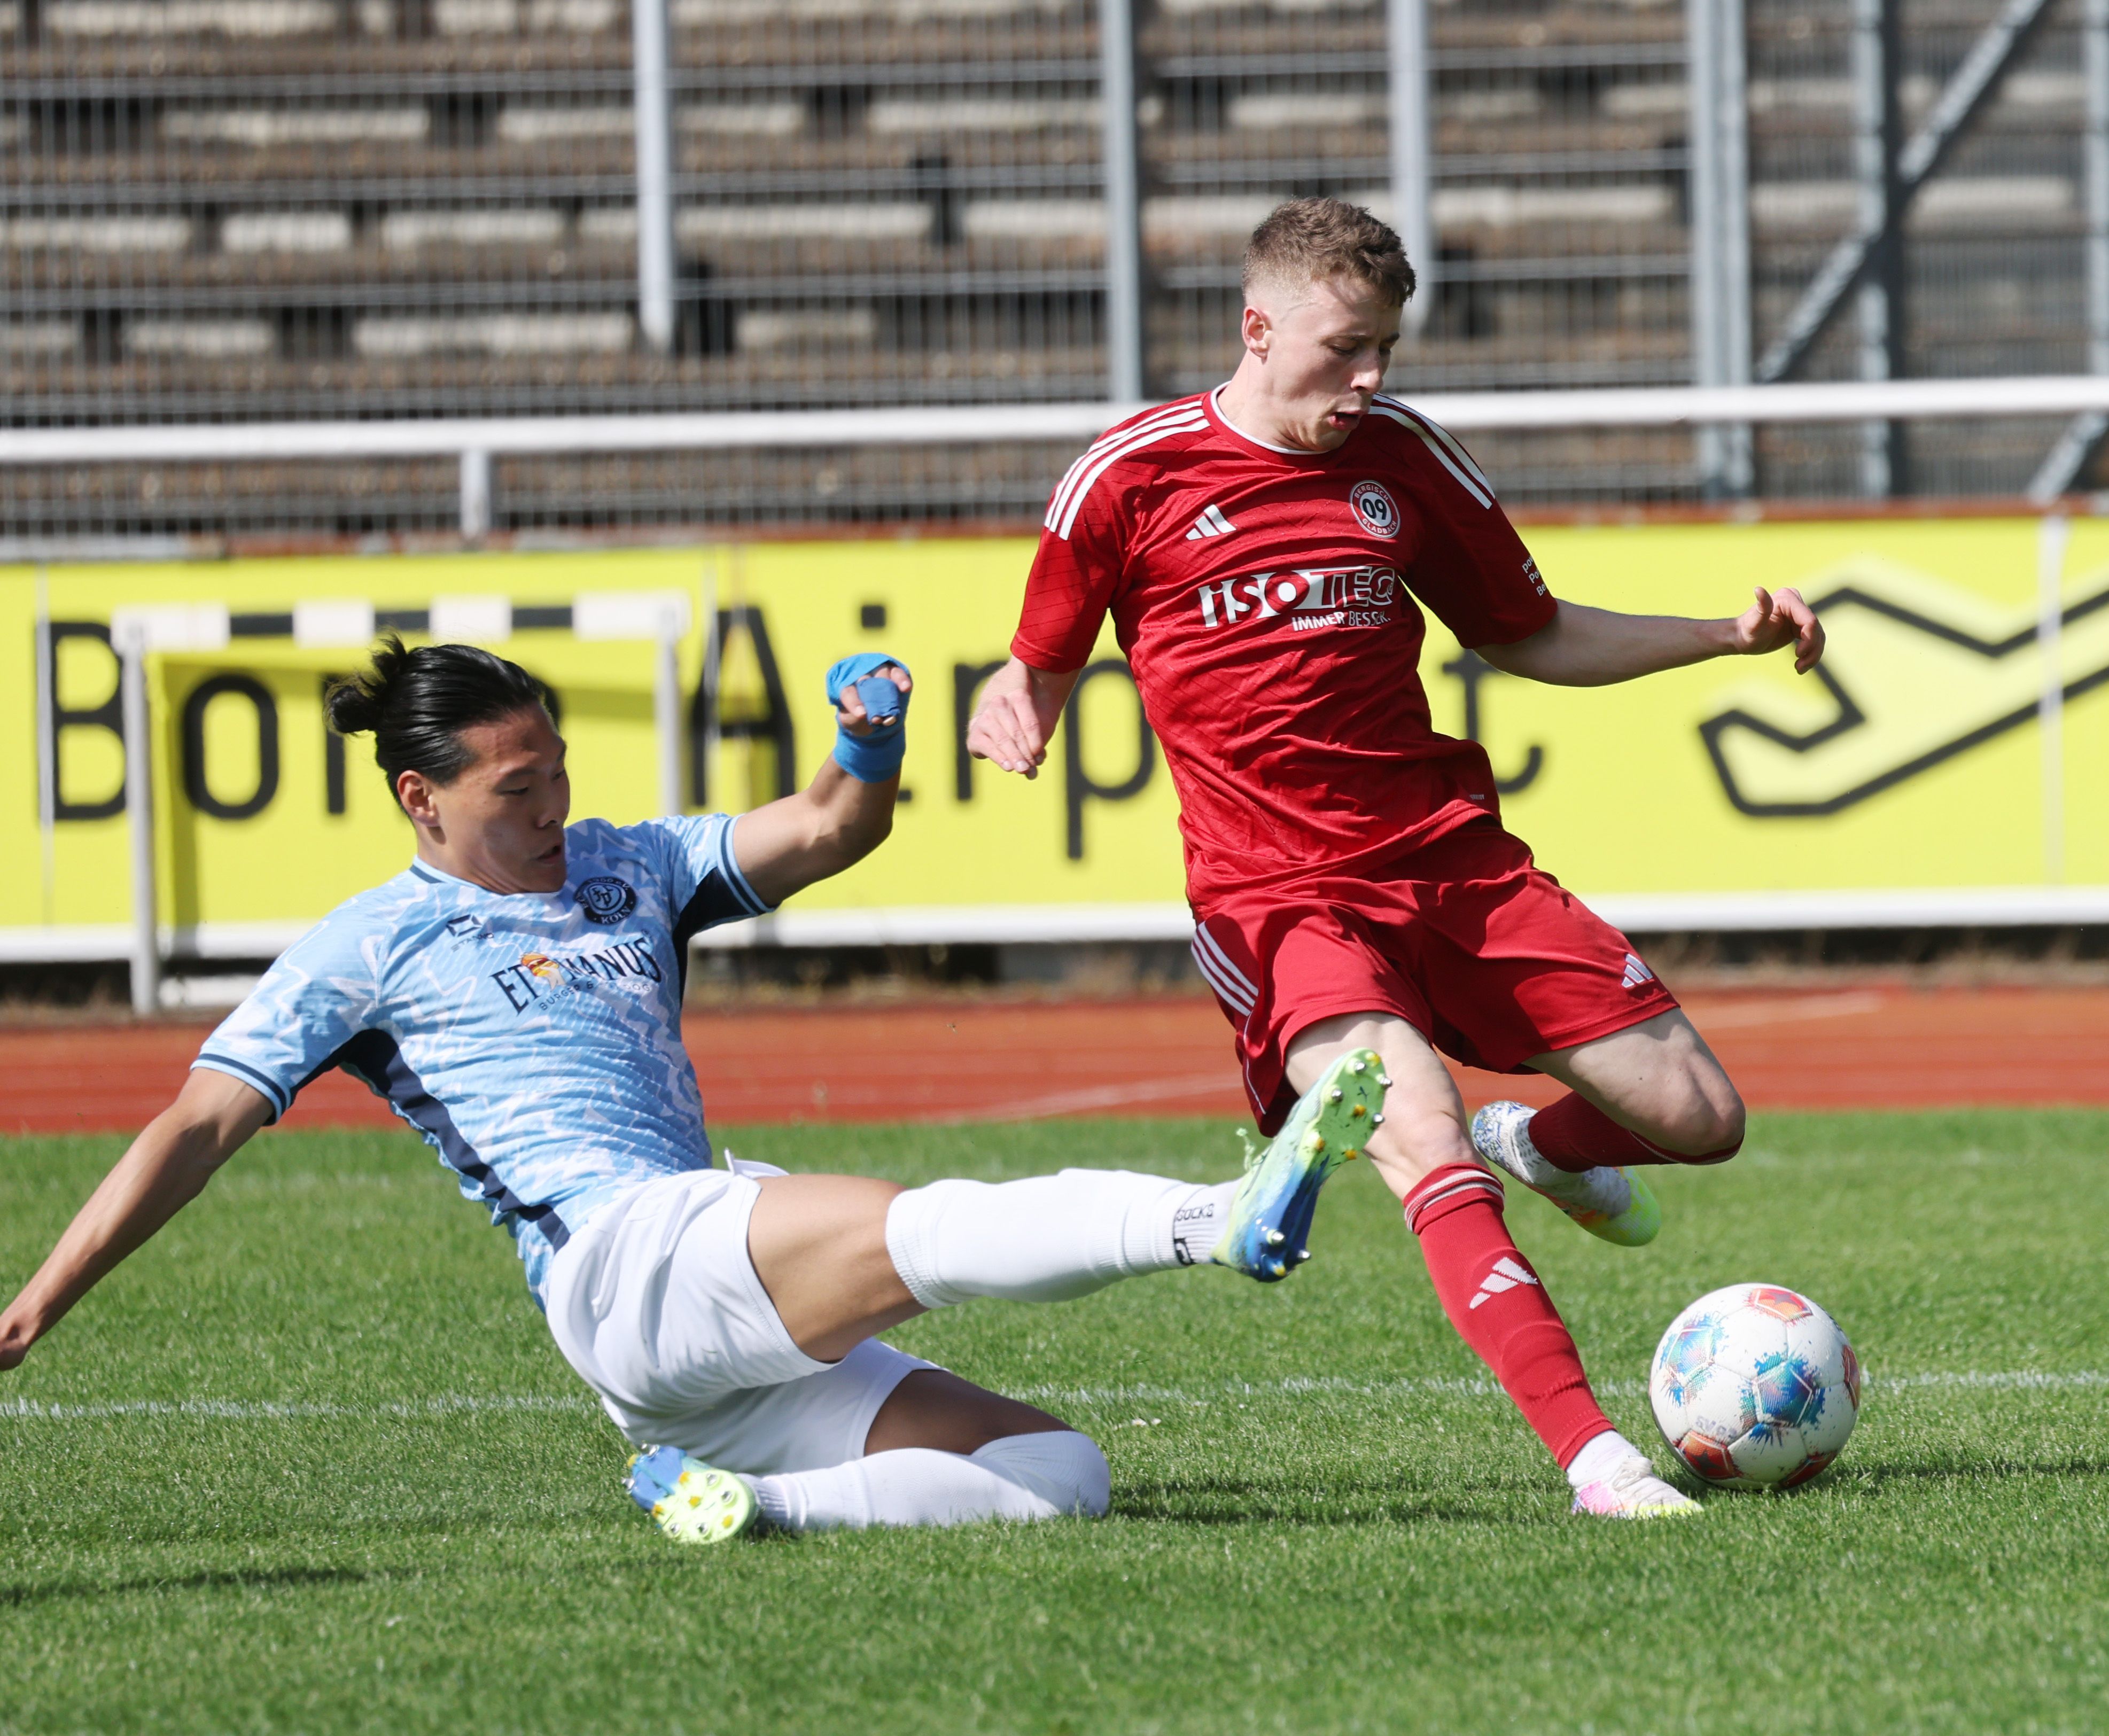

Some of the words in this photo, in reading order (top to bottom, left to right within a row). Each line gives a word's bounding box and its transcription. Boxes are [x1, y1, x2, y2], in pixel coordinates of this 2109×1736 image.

[1355, 485, 1389, 501] BERGISCH
[1362, 498, 1387, 520] 09
[1362, 518, 1397, 534] GLADBACH
[1292, 611, 1345, 631] IMMER
[490, 963, 541, 1016] ET
[554, 937, 662, 984] MANUS
[539, 984, 580, 1011] BURGER
[1176, 1203, 1215, 1221] SOCKS
